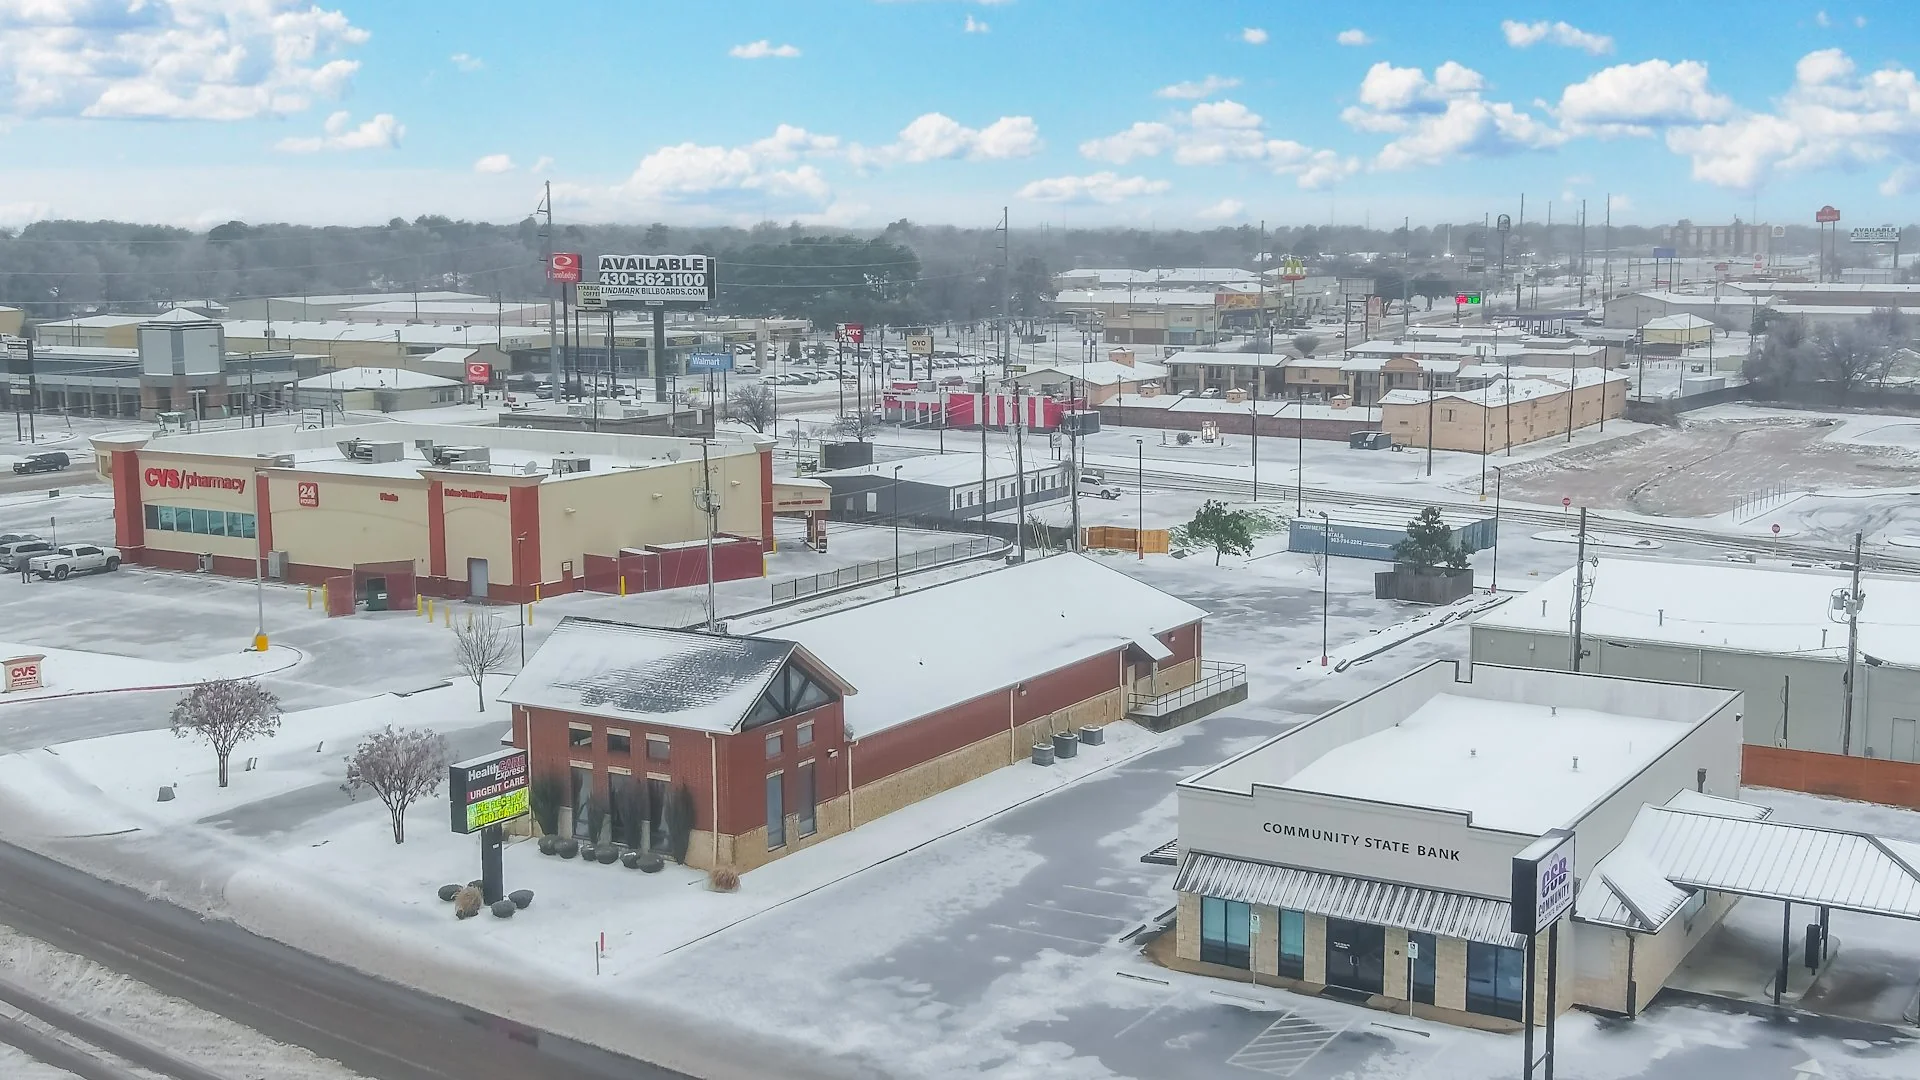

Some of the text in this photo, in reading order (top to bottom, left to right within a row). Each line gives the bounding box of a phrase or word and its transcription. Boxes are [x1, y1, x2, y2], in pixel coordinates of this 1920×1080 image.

[601, 258, 704, 271] AVAILABLE
[600, 272, 705, 286] 430-562-1100
[692, 356, 720, 366] Walmart
[300, 485, 316, 498] 24
[11, 666, 37, 678] CVS
[494, 765, 525, 781] Express
[470, 776, 525, 800] URGENT CARE
[1263, 822, 1461, 862] COMMUNITY STATE BANK
[1538, 882, 1570, 917] COMMUNITY
